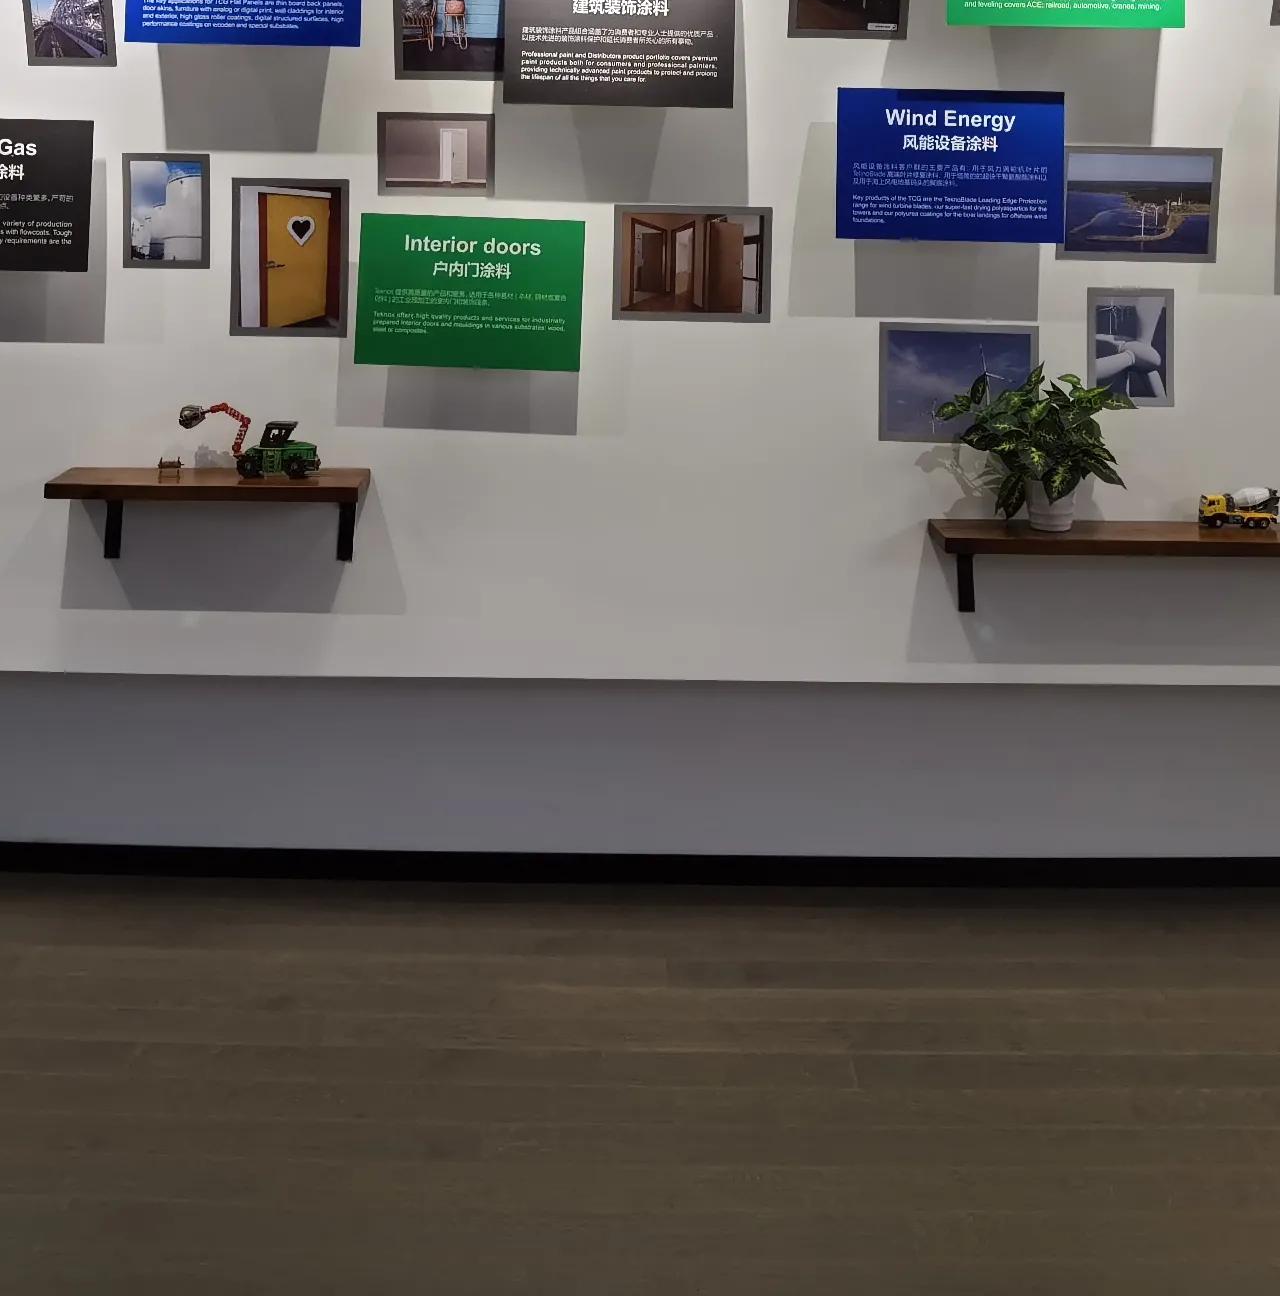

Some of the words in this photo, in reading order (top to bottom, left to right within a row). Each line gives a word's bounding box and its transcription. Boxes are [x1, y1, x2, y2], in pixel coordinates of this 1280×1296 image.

[884, 107, 936, 126] Wind
[943, 109, 1015, 132] Energy
[902, 133, 998, 152] 风能设备涂料
[404, 233, 478, 253] Interior
[482, 236, 541, 256] doors
[432, 259, 512, 279] 户内门涂料
